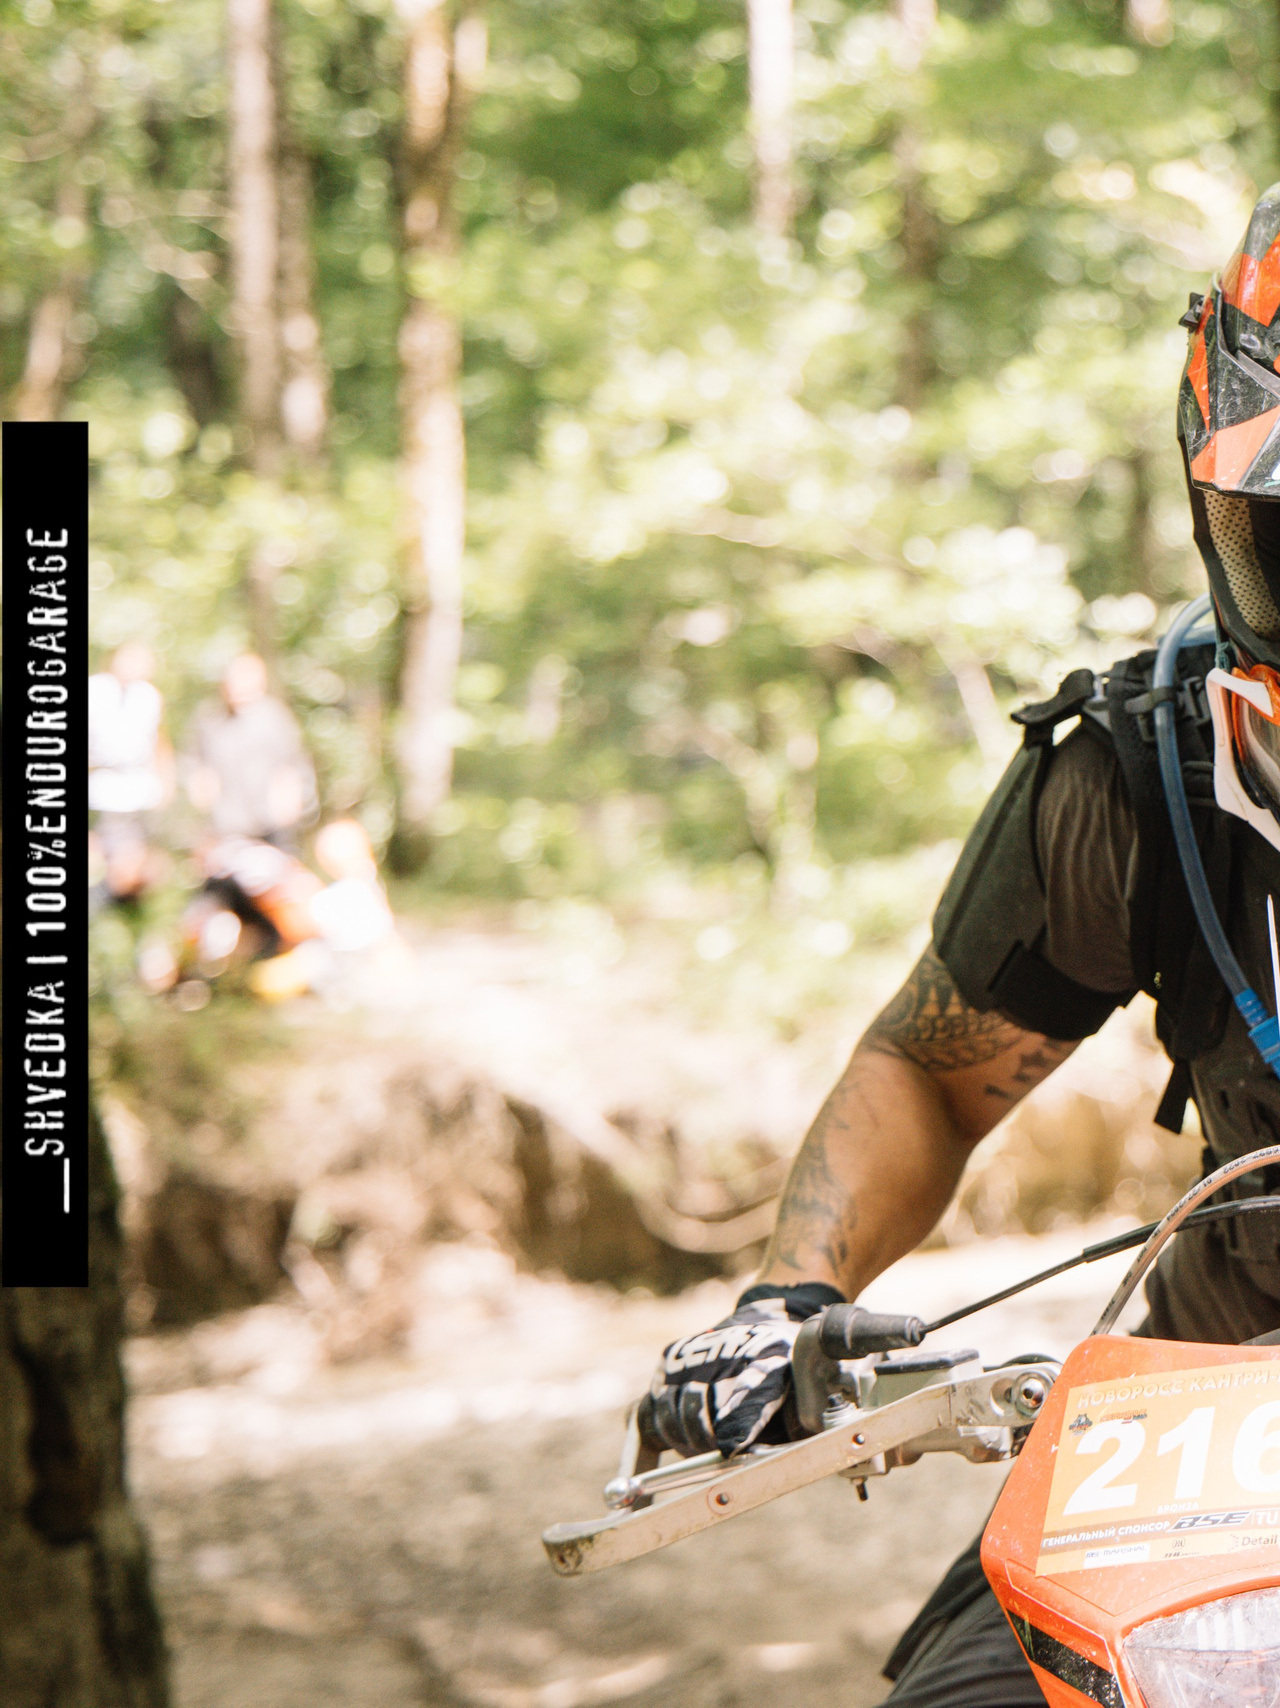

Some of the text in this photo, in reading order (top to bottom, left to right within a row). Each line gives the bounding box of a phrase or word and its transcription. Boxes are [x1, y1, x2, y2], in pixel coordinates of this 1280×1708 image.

[1077, 1381, 1184, 1409] НОВОРОСС
[1157, 1501, 1200, 1514] БРОНЗА
[1256, 1511, 1279, 1526] TU
[1041, 1521, 1171, 1548] ГЕНЕРАЛЬНЫЙ СПОНСОР
[1241, 1533, 1279, 1547] Detail
